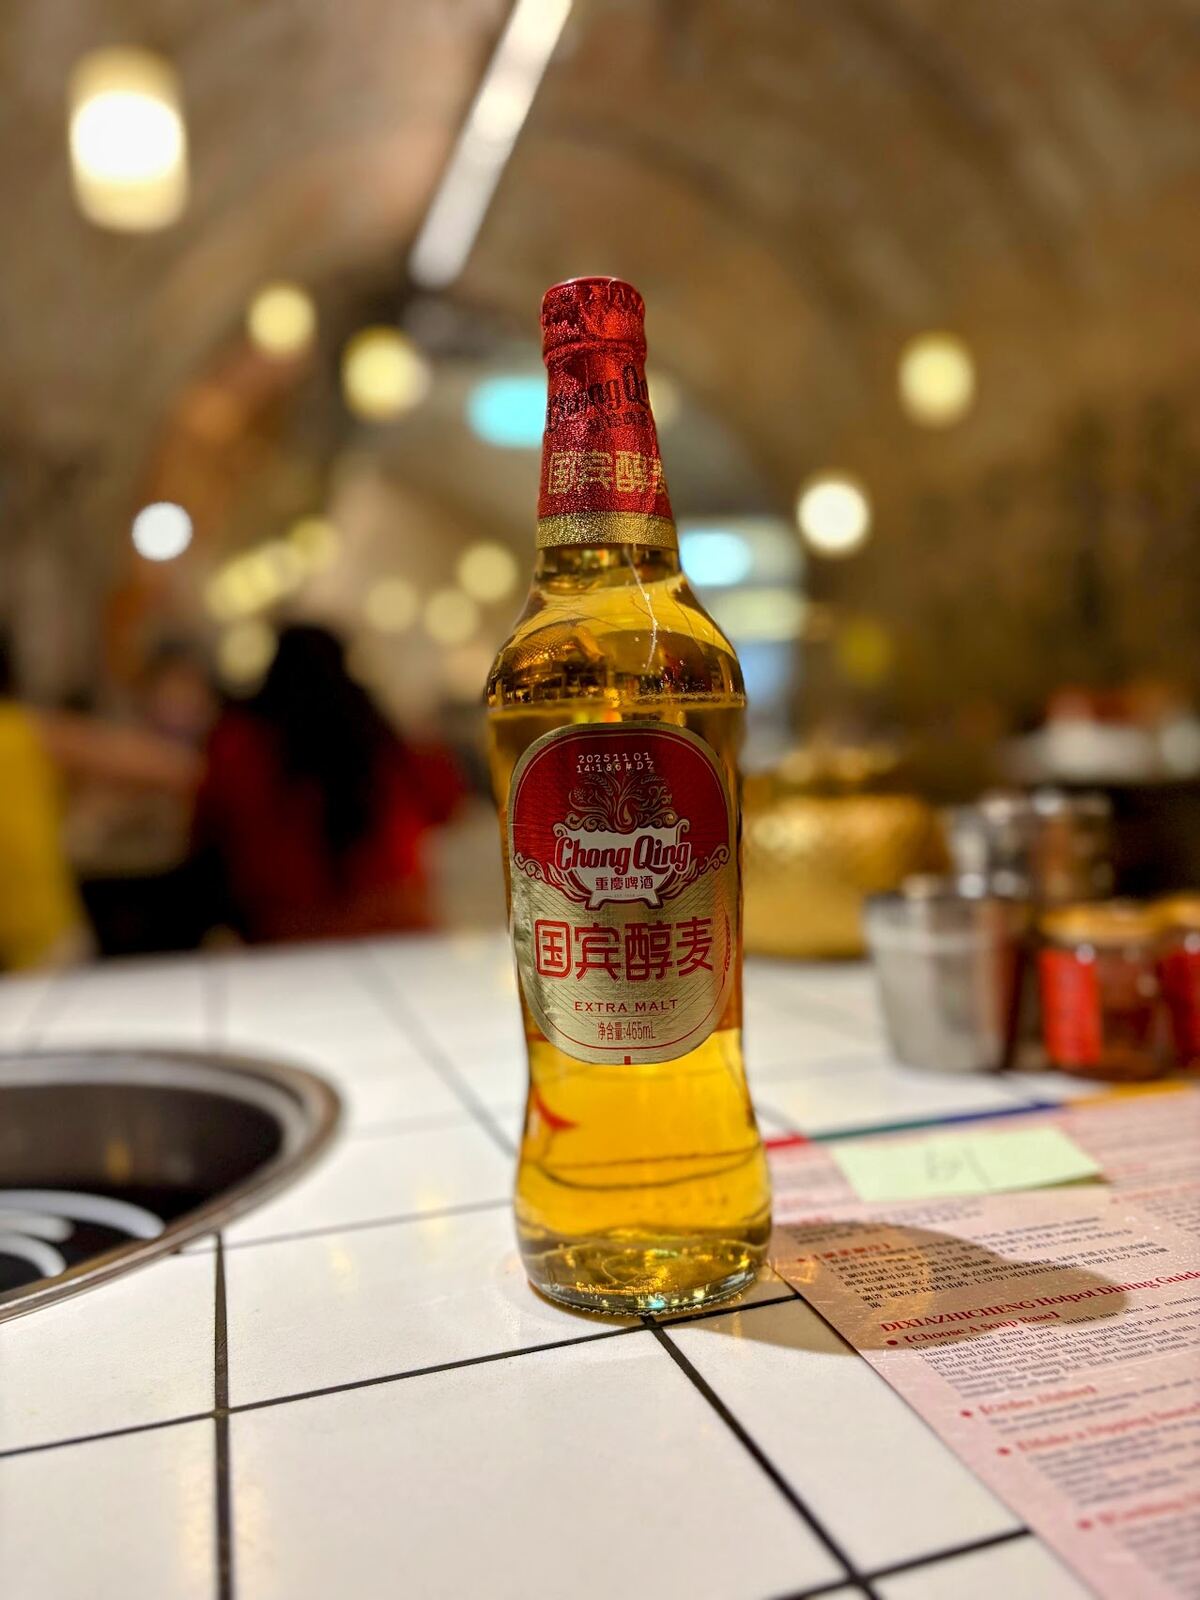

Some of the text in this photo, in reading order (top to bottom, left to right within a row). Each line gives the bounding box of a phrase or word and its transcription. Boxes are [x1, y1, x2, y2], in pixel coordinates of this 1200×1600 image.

[578, 752, 651, 764] 20251101
[555, 835, 692, 875] Chong Qing
[535, 916, 714, 981] 国宾醇麦
[574, 1000, 678, 1013] EXTRA MALT
[597, 1022, 656, 1041] 净含量:465mL
[879, 1299, 1036, 1333] DIXIAZHICHENG
[1033, 1288, 1101, 1307] Hotpot
[1094, 1277, 1161, 1297] Dining
[910, 1343, 930, 1351] We
[932, 1338, 959, 1348] offer
[962, 1332, 994, 1343] three
[996, 1329, 1026, 1338] soup
[1061, 1314, 1096, 1325] which
[1098, 1310, 1119, 1318] can
[1119, 1305, 1144, 1314] also
[1144, 1302, 1161, 1310] be
[978, 1318, 1020, 1332] Soup
